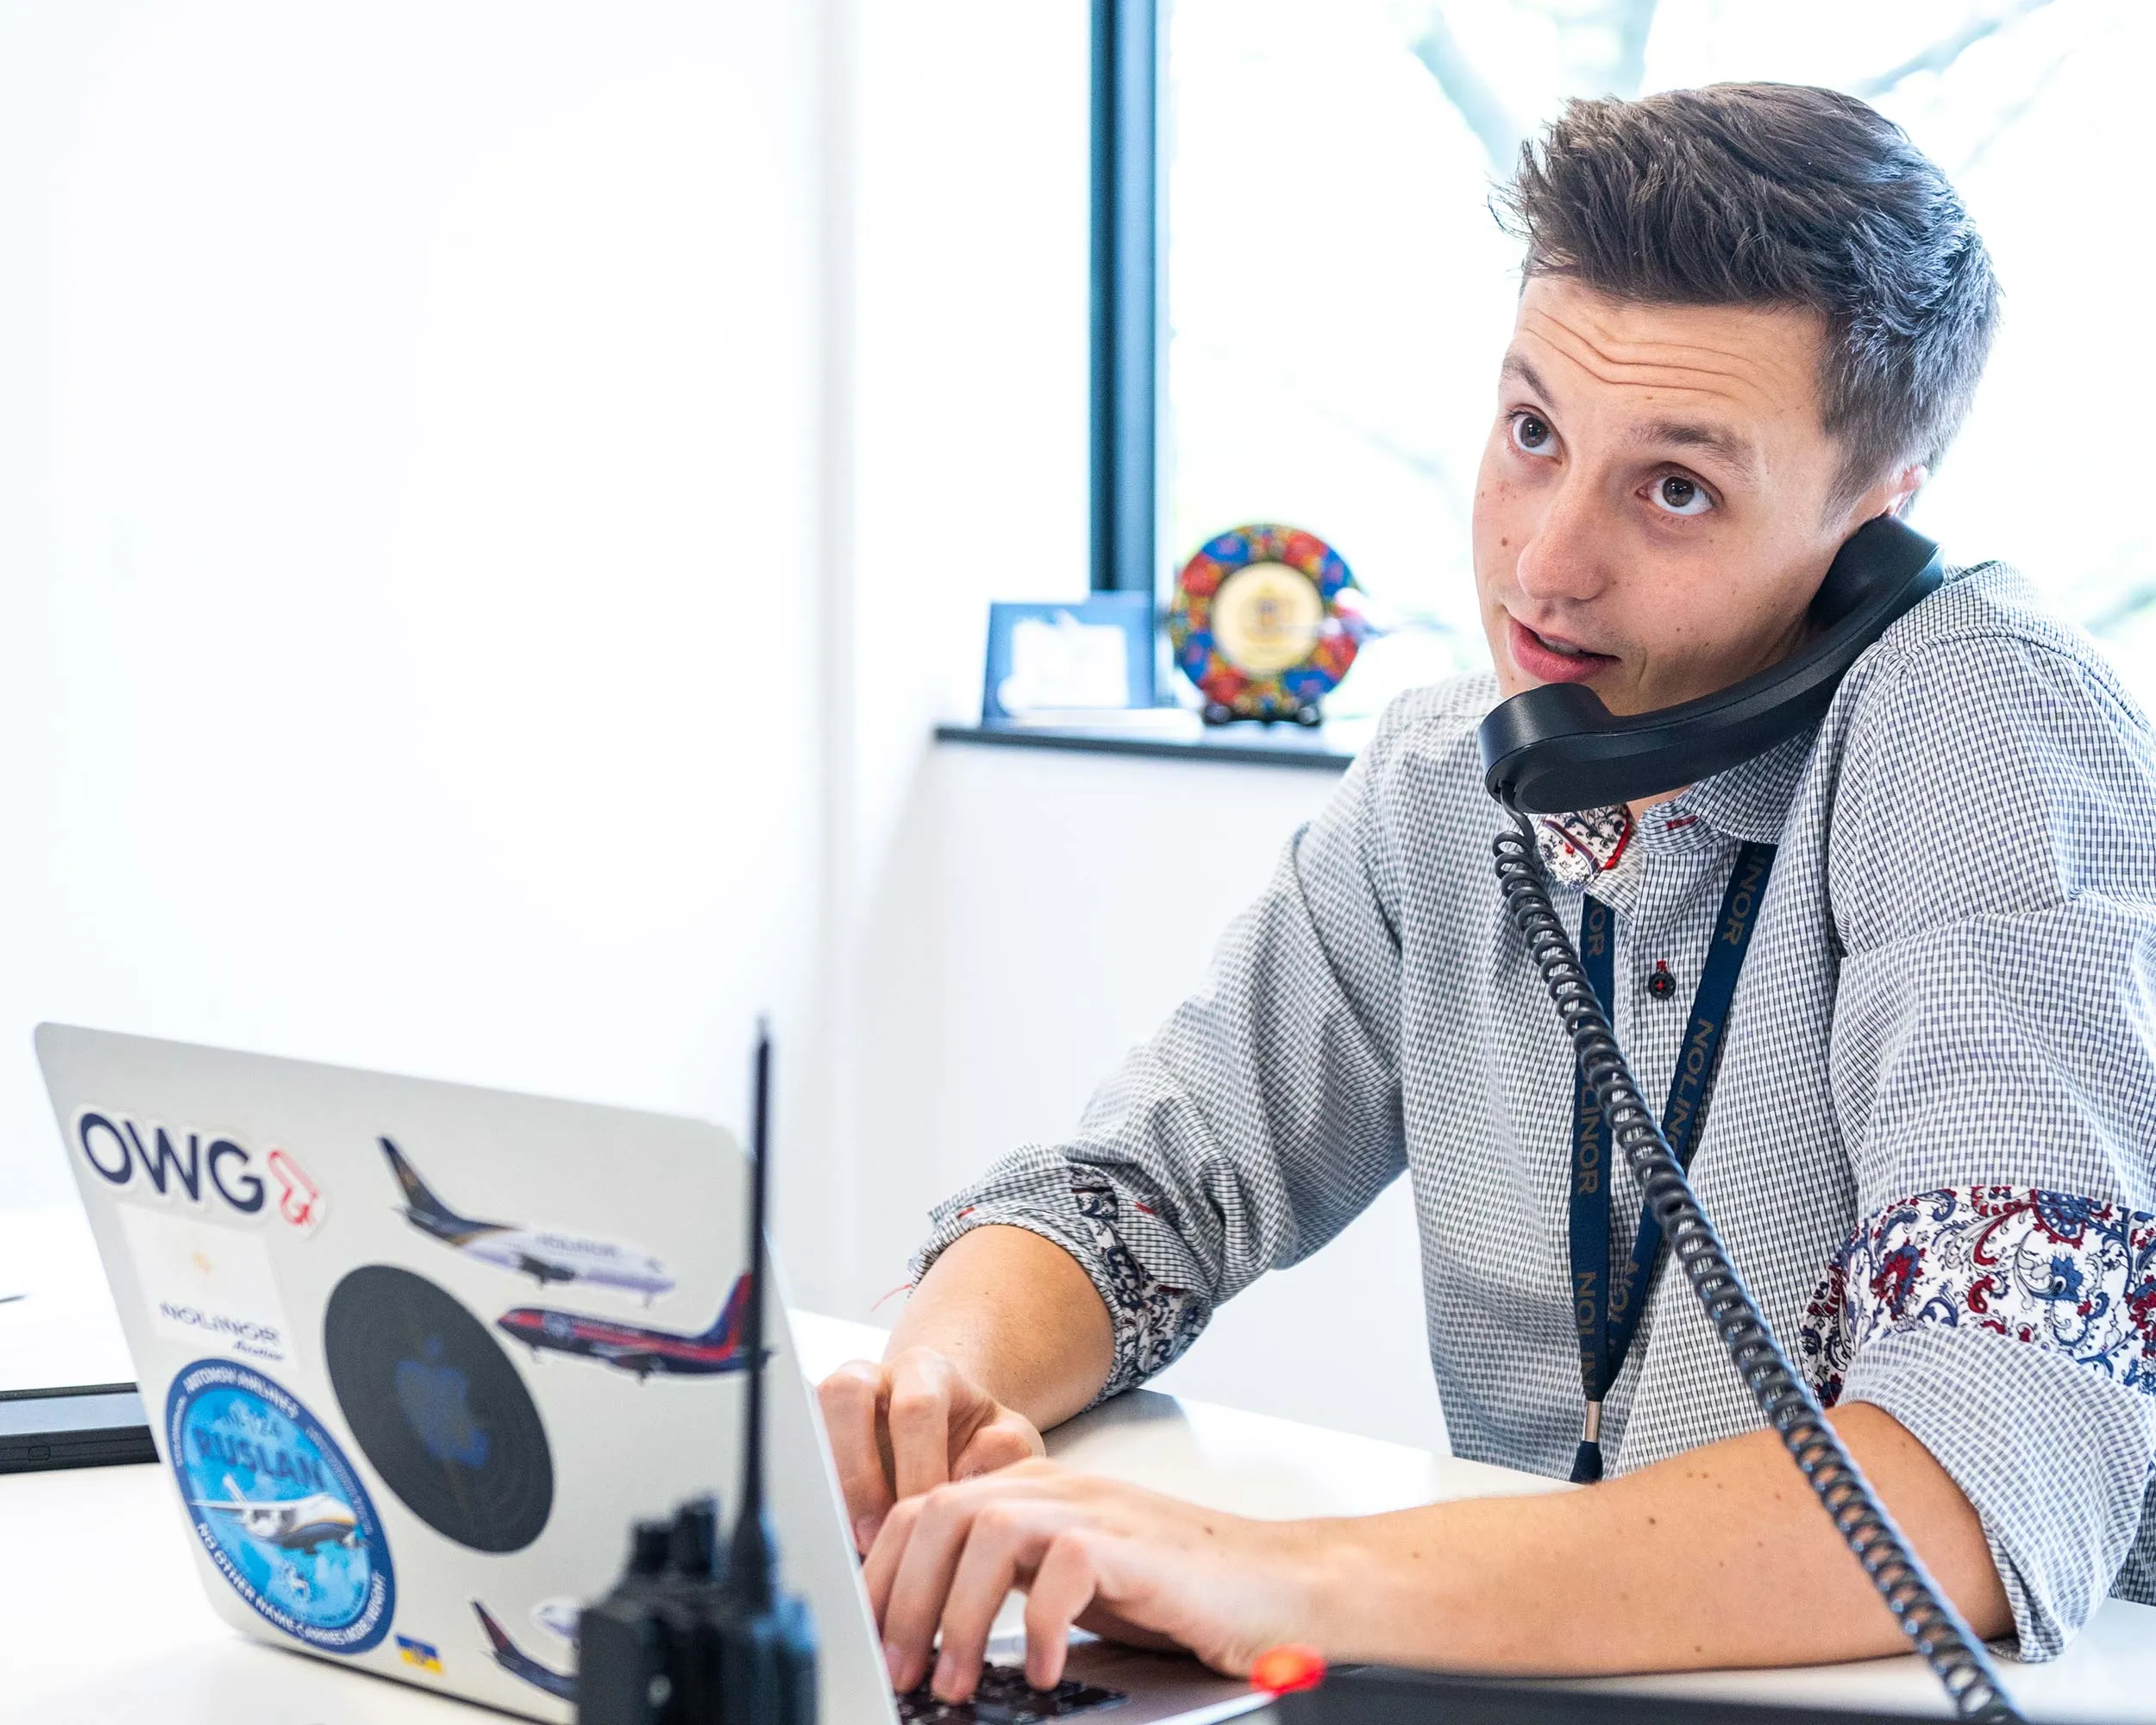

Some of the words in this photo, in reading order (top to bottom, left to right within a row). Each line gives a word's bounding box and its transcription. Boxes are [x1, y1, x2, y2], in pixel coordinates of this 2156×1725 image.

[1588, 901, 1607, 958] OR
[79, 1113, 266, 1213] OWG
[159, 1301, 281, 1346] NOLINOR
